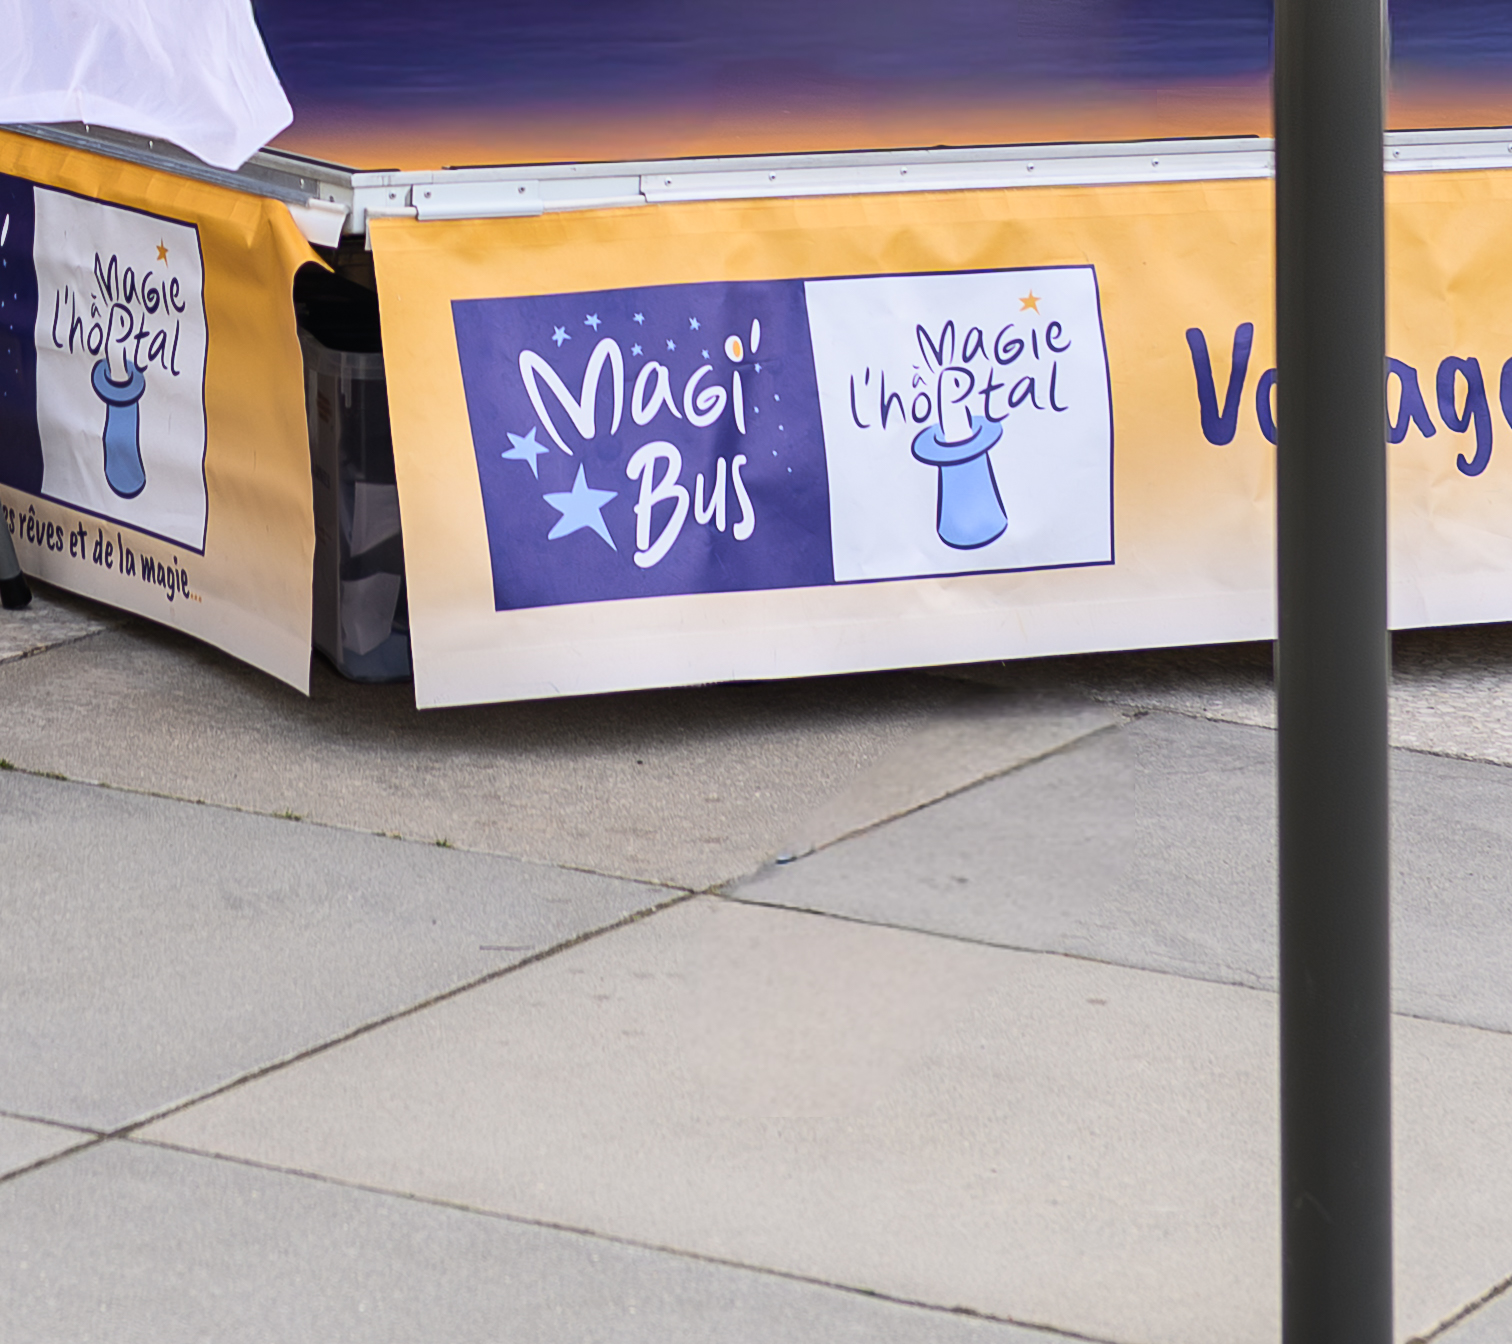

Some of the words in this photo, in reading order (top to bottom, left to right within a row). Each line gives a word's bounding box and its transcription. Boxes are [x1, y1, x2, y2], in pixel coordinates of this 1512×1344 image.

[94, 252, 185, 316] Magie
[915, 320, 1072, 374] Magie
[626, 440, 754, 569] Bus
[20, 504, 64, 552] rêves
[70, 521, 87, 560] et
[93, 528, 113, 569] de
[117, 533, 136, 577] la
